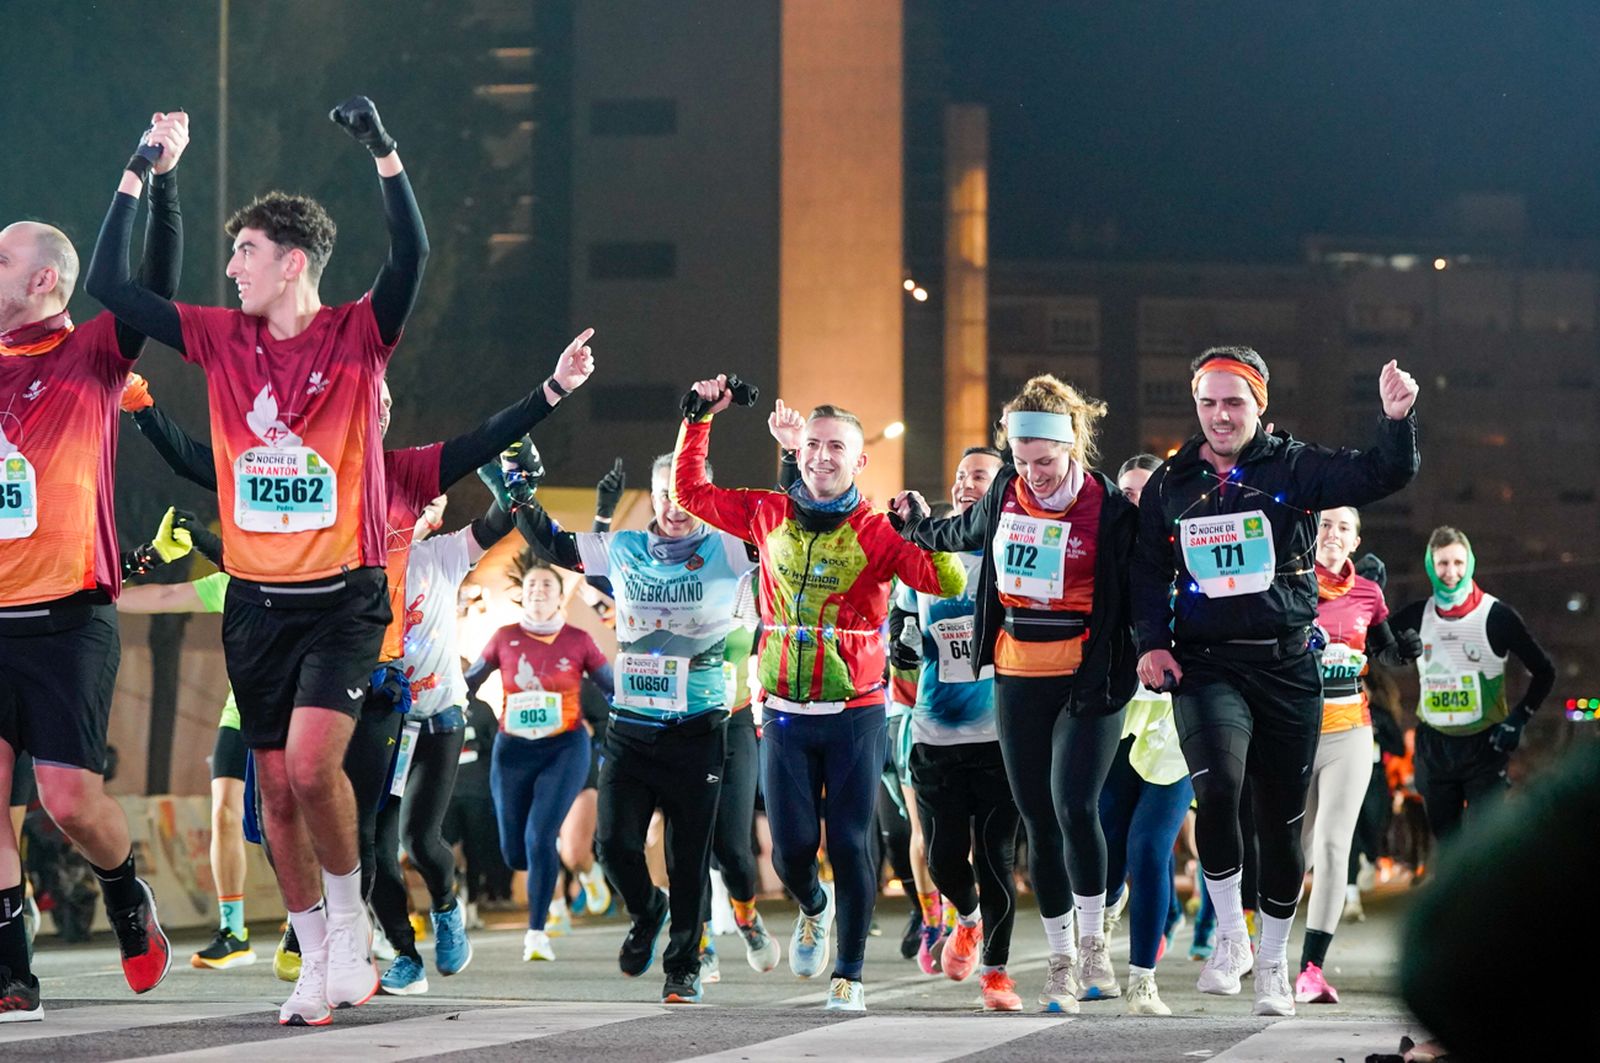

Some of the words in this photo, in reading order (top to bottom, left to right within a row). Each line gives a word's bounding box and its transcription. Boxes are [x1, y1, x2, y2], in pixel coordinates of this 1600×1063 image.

[264, 427, 288, 441] 47
[256, 455, 285, 465] NOCHE
[287, 457, 297, 465] DE
[245, 465, 264, 475] SAN
[247, 477, 324, 503] 12562
[1027, 526, 1037, 534] DE
[1199, 525, 1224, 535] NOCHE
[1225, 524, 1236, 532] DE
[1190, 537, 1207, 546] SAN
[1006, 543, 1038, 570] 172
[1211, 543, 1245, 568] 171
[792, 570, 840, 585] HYUNDAI
[942, 632, 955, 640] SAN
[950, 640, 972, 660] 64
[629, 675, 669, 692] 10850
[1432, 691, 1469, 707] 5843
[520, 708, 547, 724] 903
